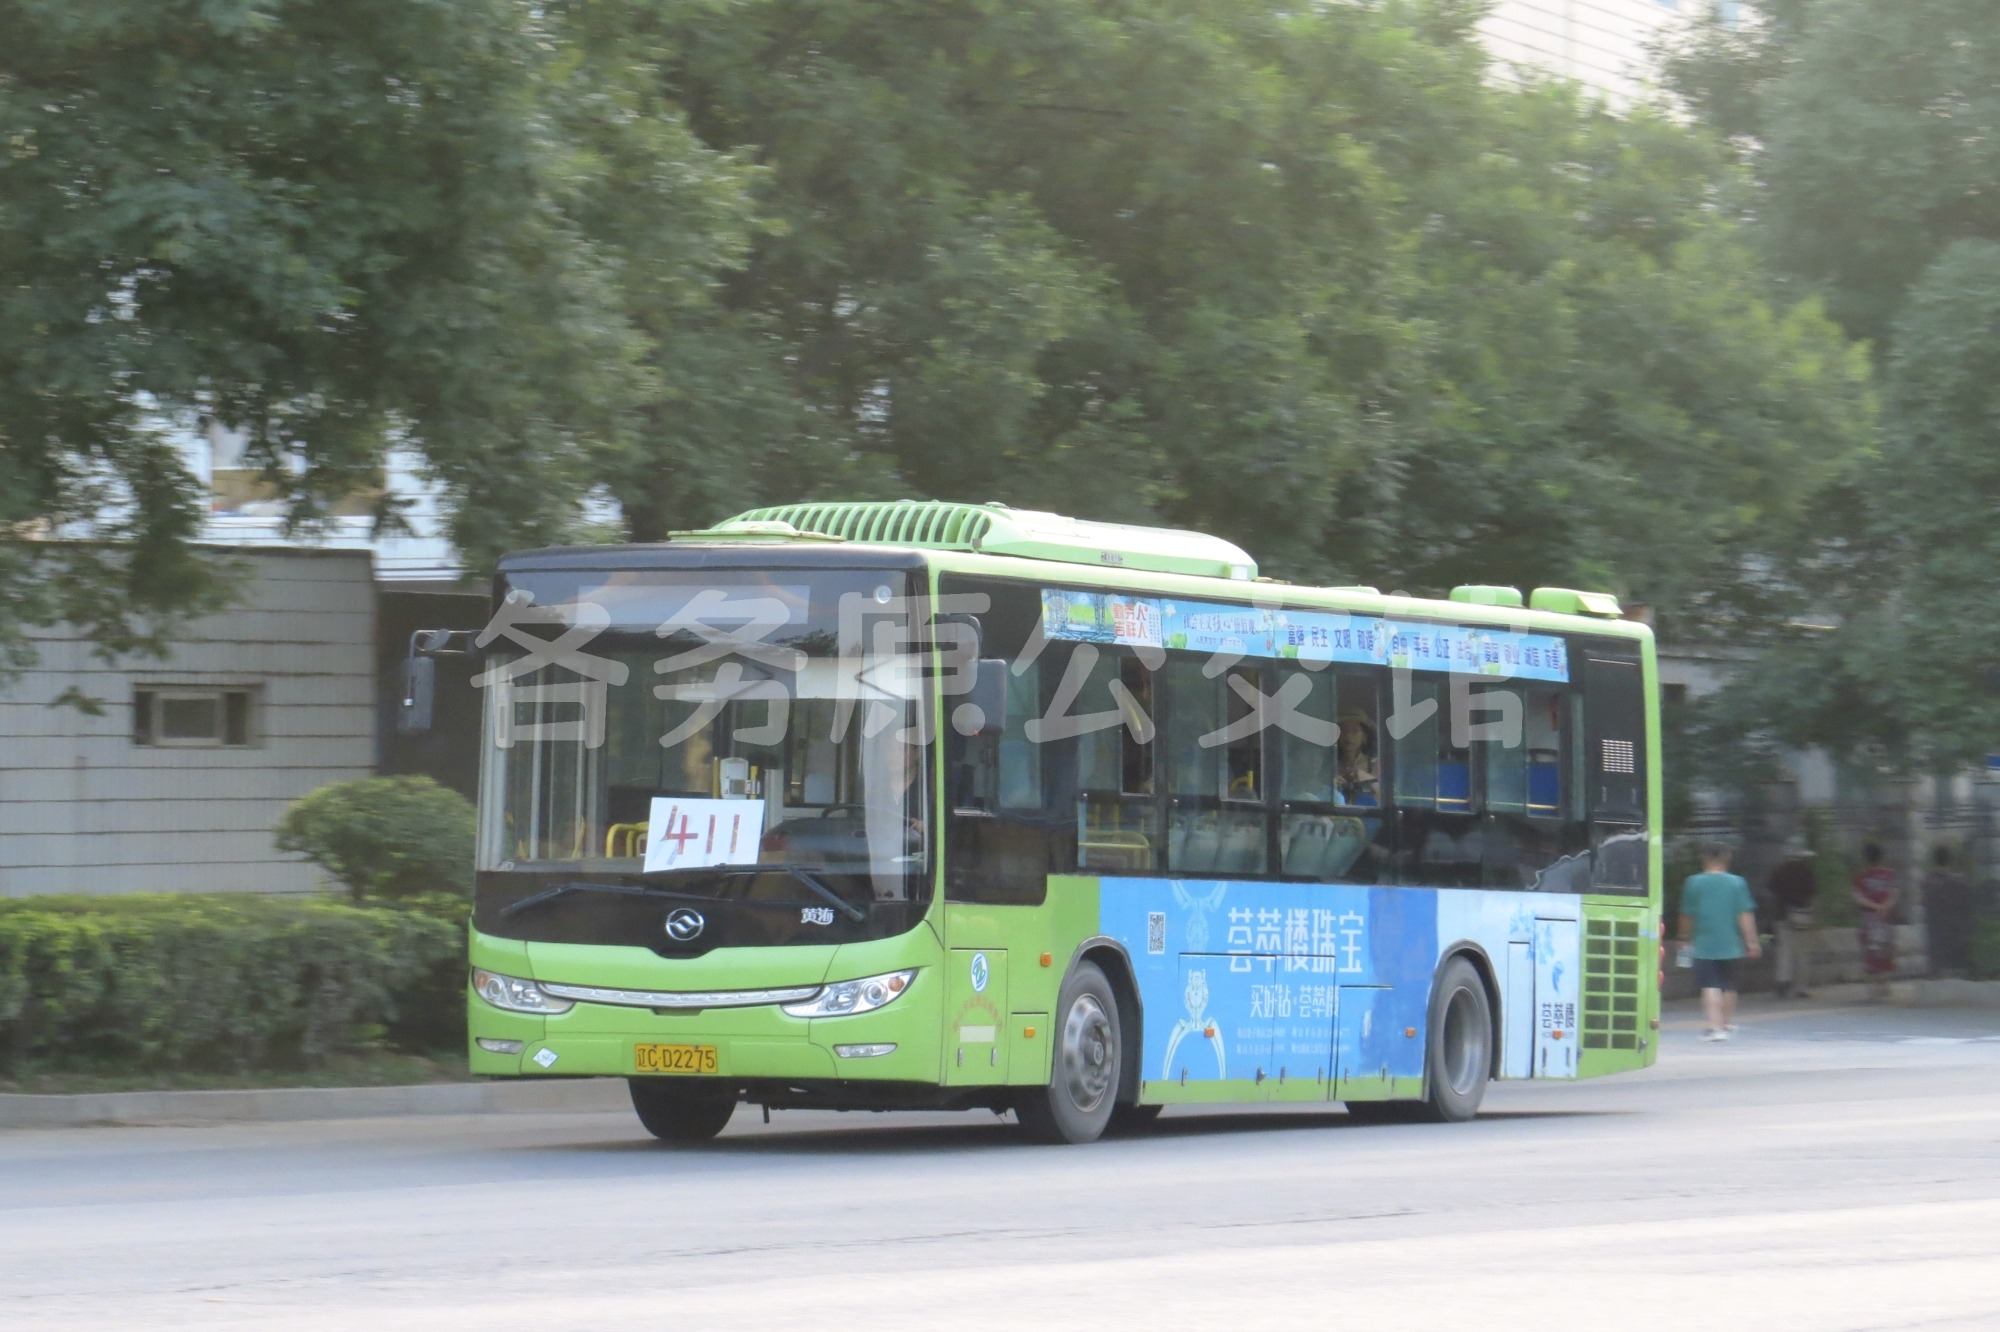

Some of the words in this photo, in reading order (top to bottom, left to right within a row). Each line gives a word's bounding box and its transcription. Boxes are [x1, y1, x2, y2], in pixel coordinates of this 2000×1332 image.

[1334, 628, 1351, 649] 文明
[1392, 635, 1408, 655] 自由
[662, 805, 740, 855] 411
[801, 907, 835, 926] 黄海
[1228, 907, 1364, 973] 荟萃楼珠宝
[1541, 1002, 1575, 1028] 荟萃楼
